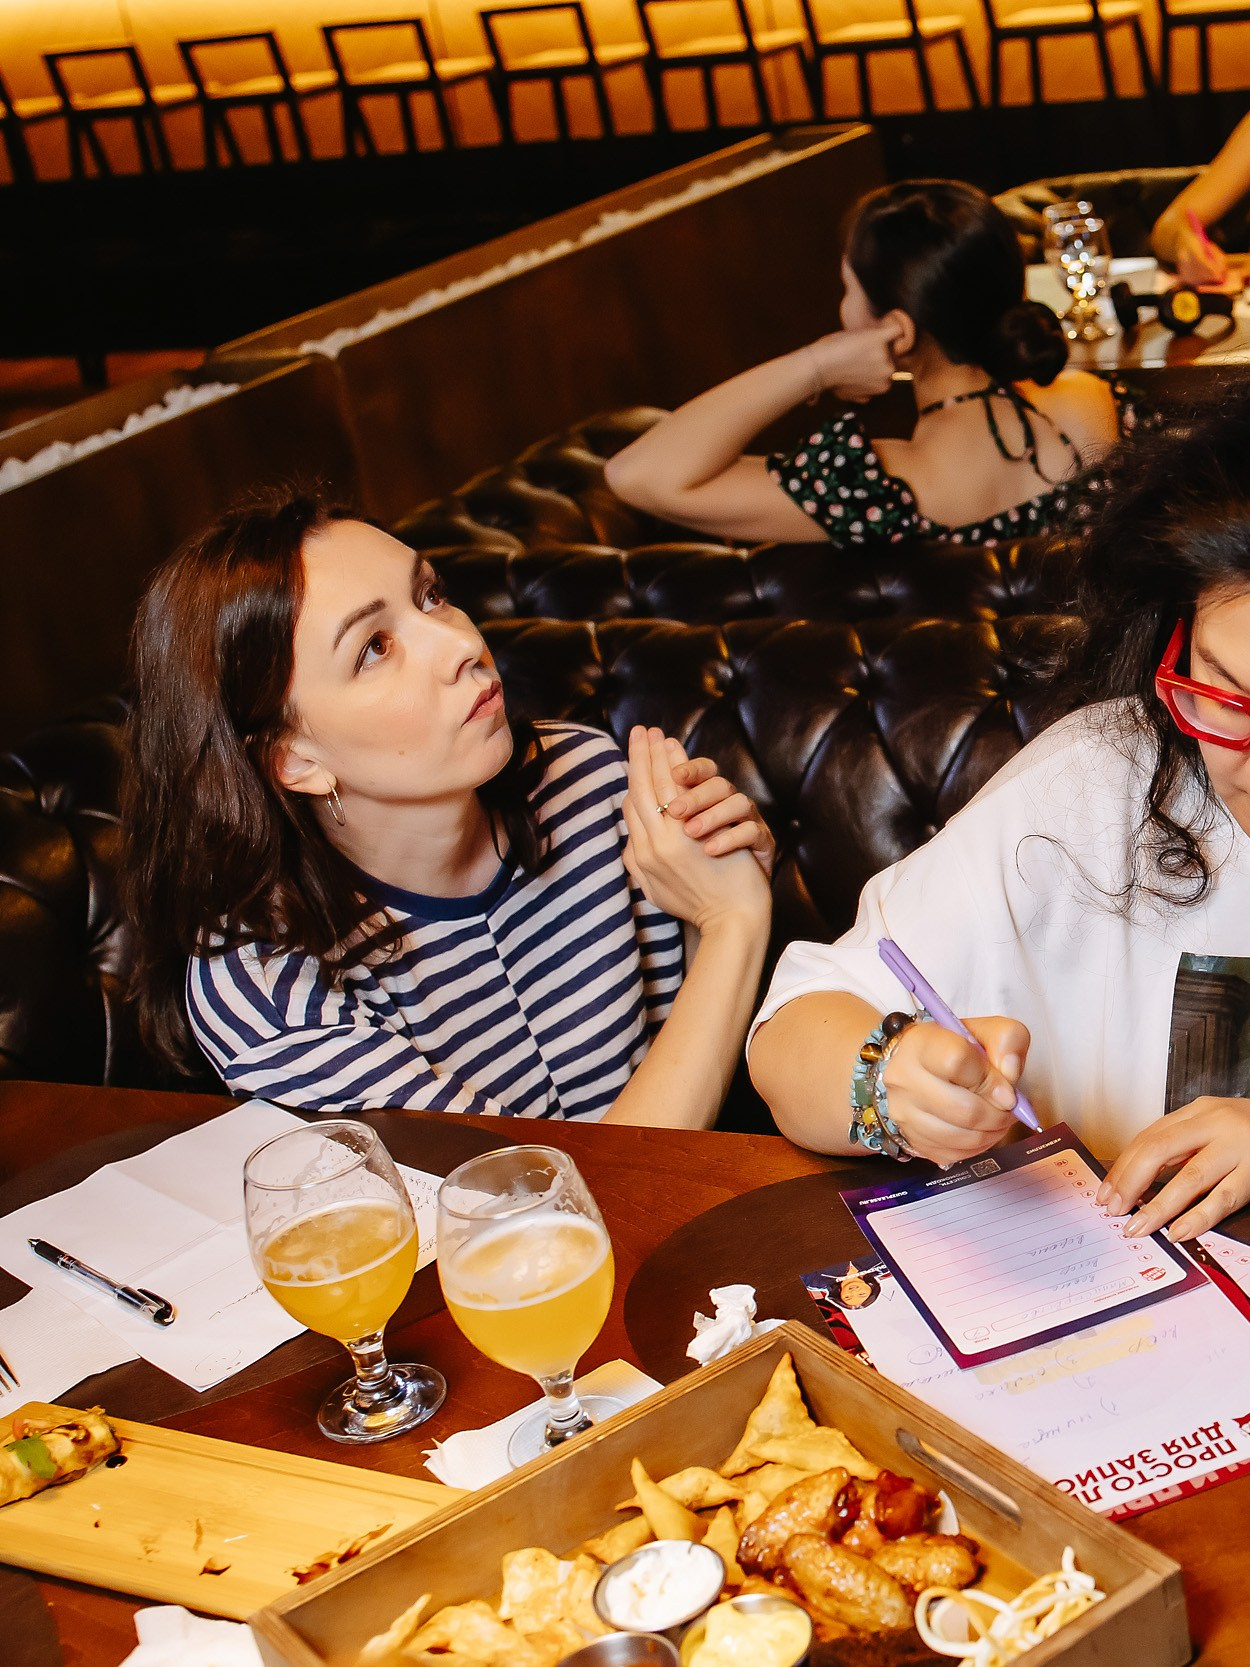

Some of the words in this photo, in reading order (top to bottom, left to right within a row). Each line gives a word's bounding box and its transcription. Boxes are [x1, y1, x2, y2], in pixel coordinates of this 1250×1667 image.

[1161, 1421, 1225, 1456] ДЛЯ
[1054, 1448, 1159, 1493] ЗАПИС
[1111, 1438, 1237, 1492] ПРОСТО
